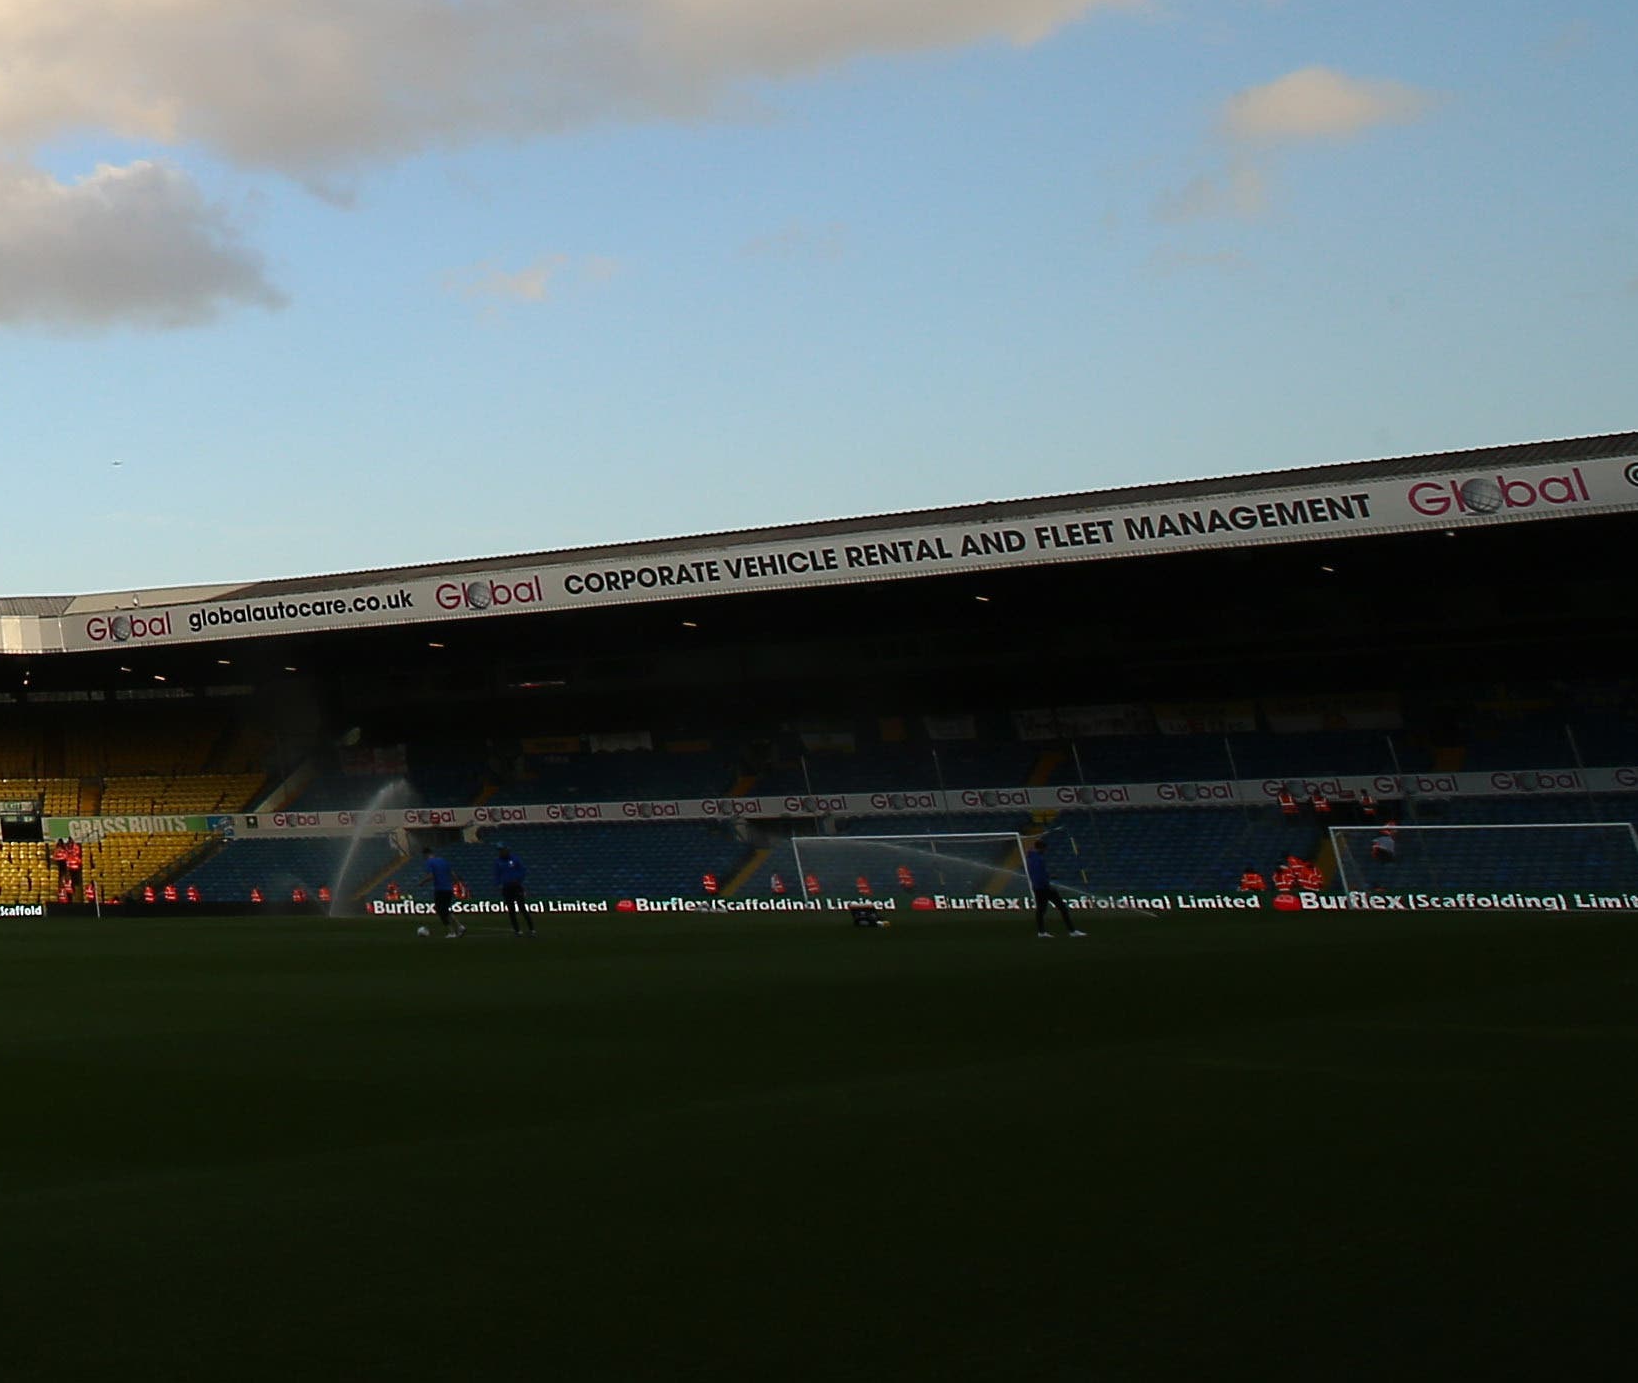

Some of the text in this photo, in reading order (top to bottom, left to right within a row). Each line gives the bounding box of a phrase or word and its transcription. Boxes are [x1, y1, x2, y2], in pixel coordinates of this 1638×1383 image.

[1407, 466, 1591, 517] Global
[435, 492, 1371, 612] Global CORPORATE VEHICLE RENTAL AND FLEET MANAGEMENT
[86, 588, 414, 643] Global globalautocare.co.uk
[372, 899, 437, 915] Burflex
[548, 900, 608, 913] Limited
[933, 895, 1261, 910] Burflex (affolding) Limited
[1299, 892, 1406, 910] Burflex
[1408, 893, 1567, 910] (Scaffolding)
